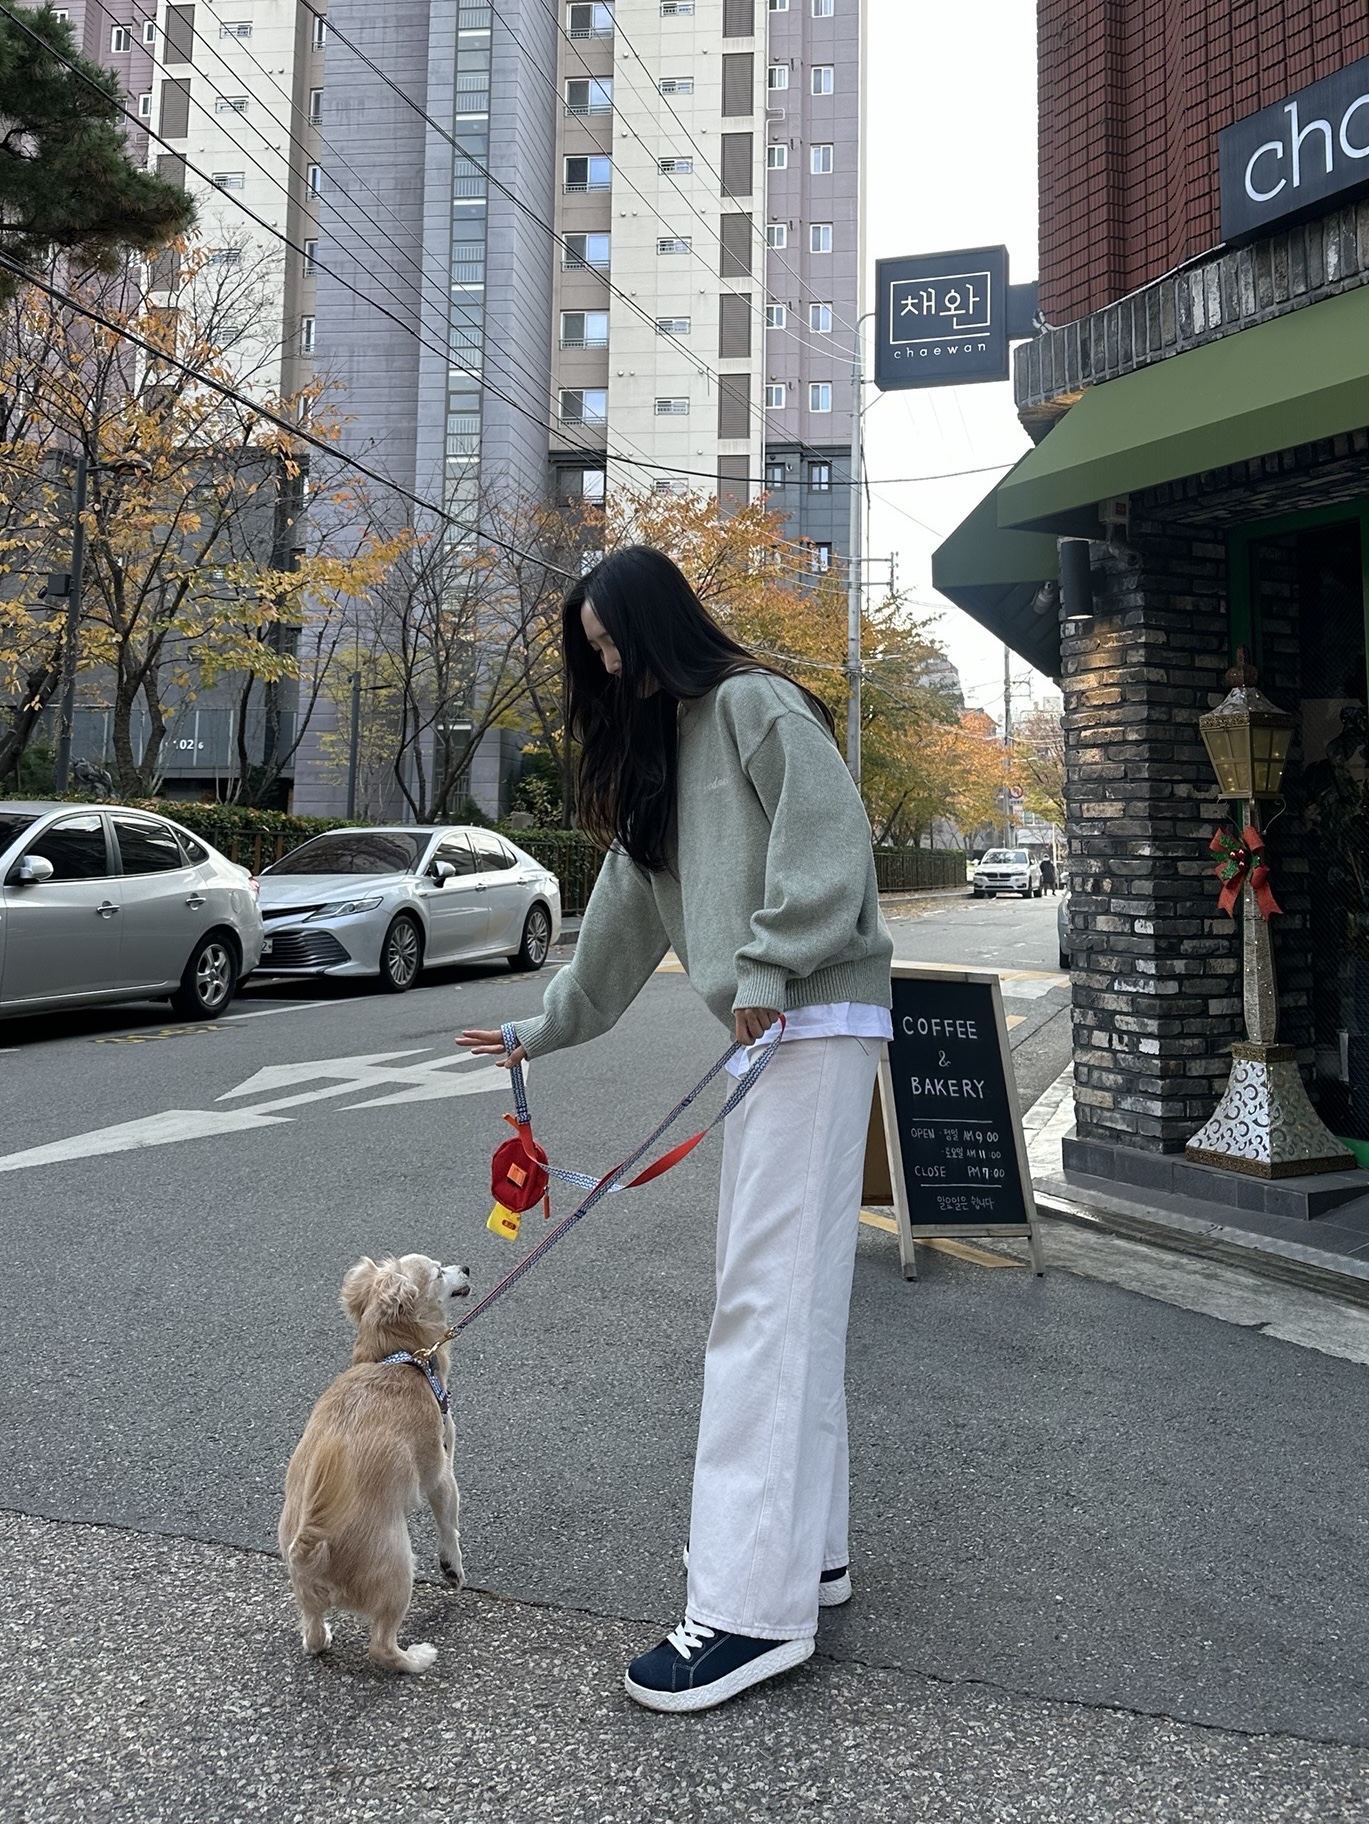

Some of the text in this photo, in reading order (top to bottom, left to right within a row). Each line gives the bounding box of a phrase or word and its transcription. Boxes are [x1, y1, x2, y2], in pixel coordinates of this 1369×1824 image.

[894, 343, 986, 359] chaewan
[902, 1016, 978, 1039] COFFEE
[938, 1050, 952, 1067] &
[911, 1077, 985, 1099] BAKERY
[911, 1127, 935, 1140] OPEN
[914, 1165, 947, 1177] CLOSE
